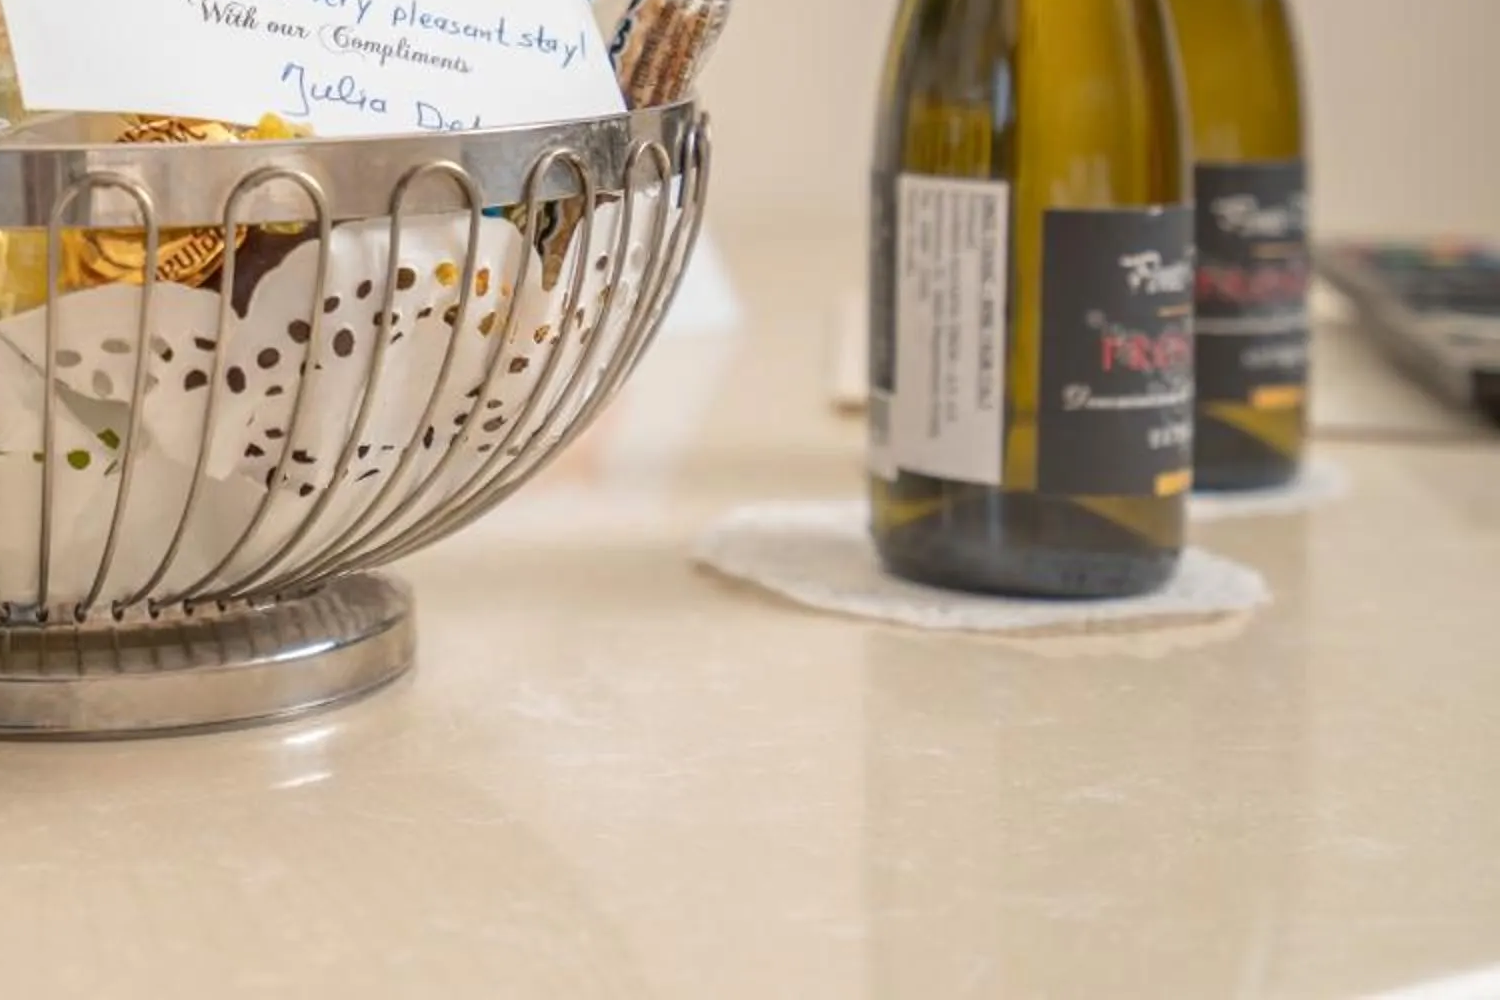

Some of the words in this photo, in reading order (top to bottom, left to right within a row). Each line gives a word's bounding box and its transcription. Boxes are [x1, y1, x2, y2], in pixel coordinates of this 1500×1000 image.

[267, 20, 312, 42] our
[320, 22, 473, 75] Compliments
[392, 0, 511, 47] pleasant
[516, 24, 586, 69] stay!
[281, 61, 387, 118] Julia
